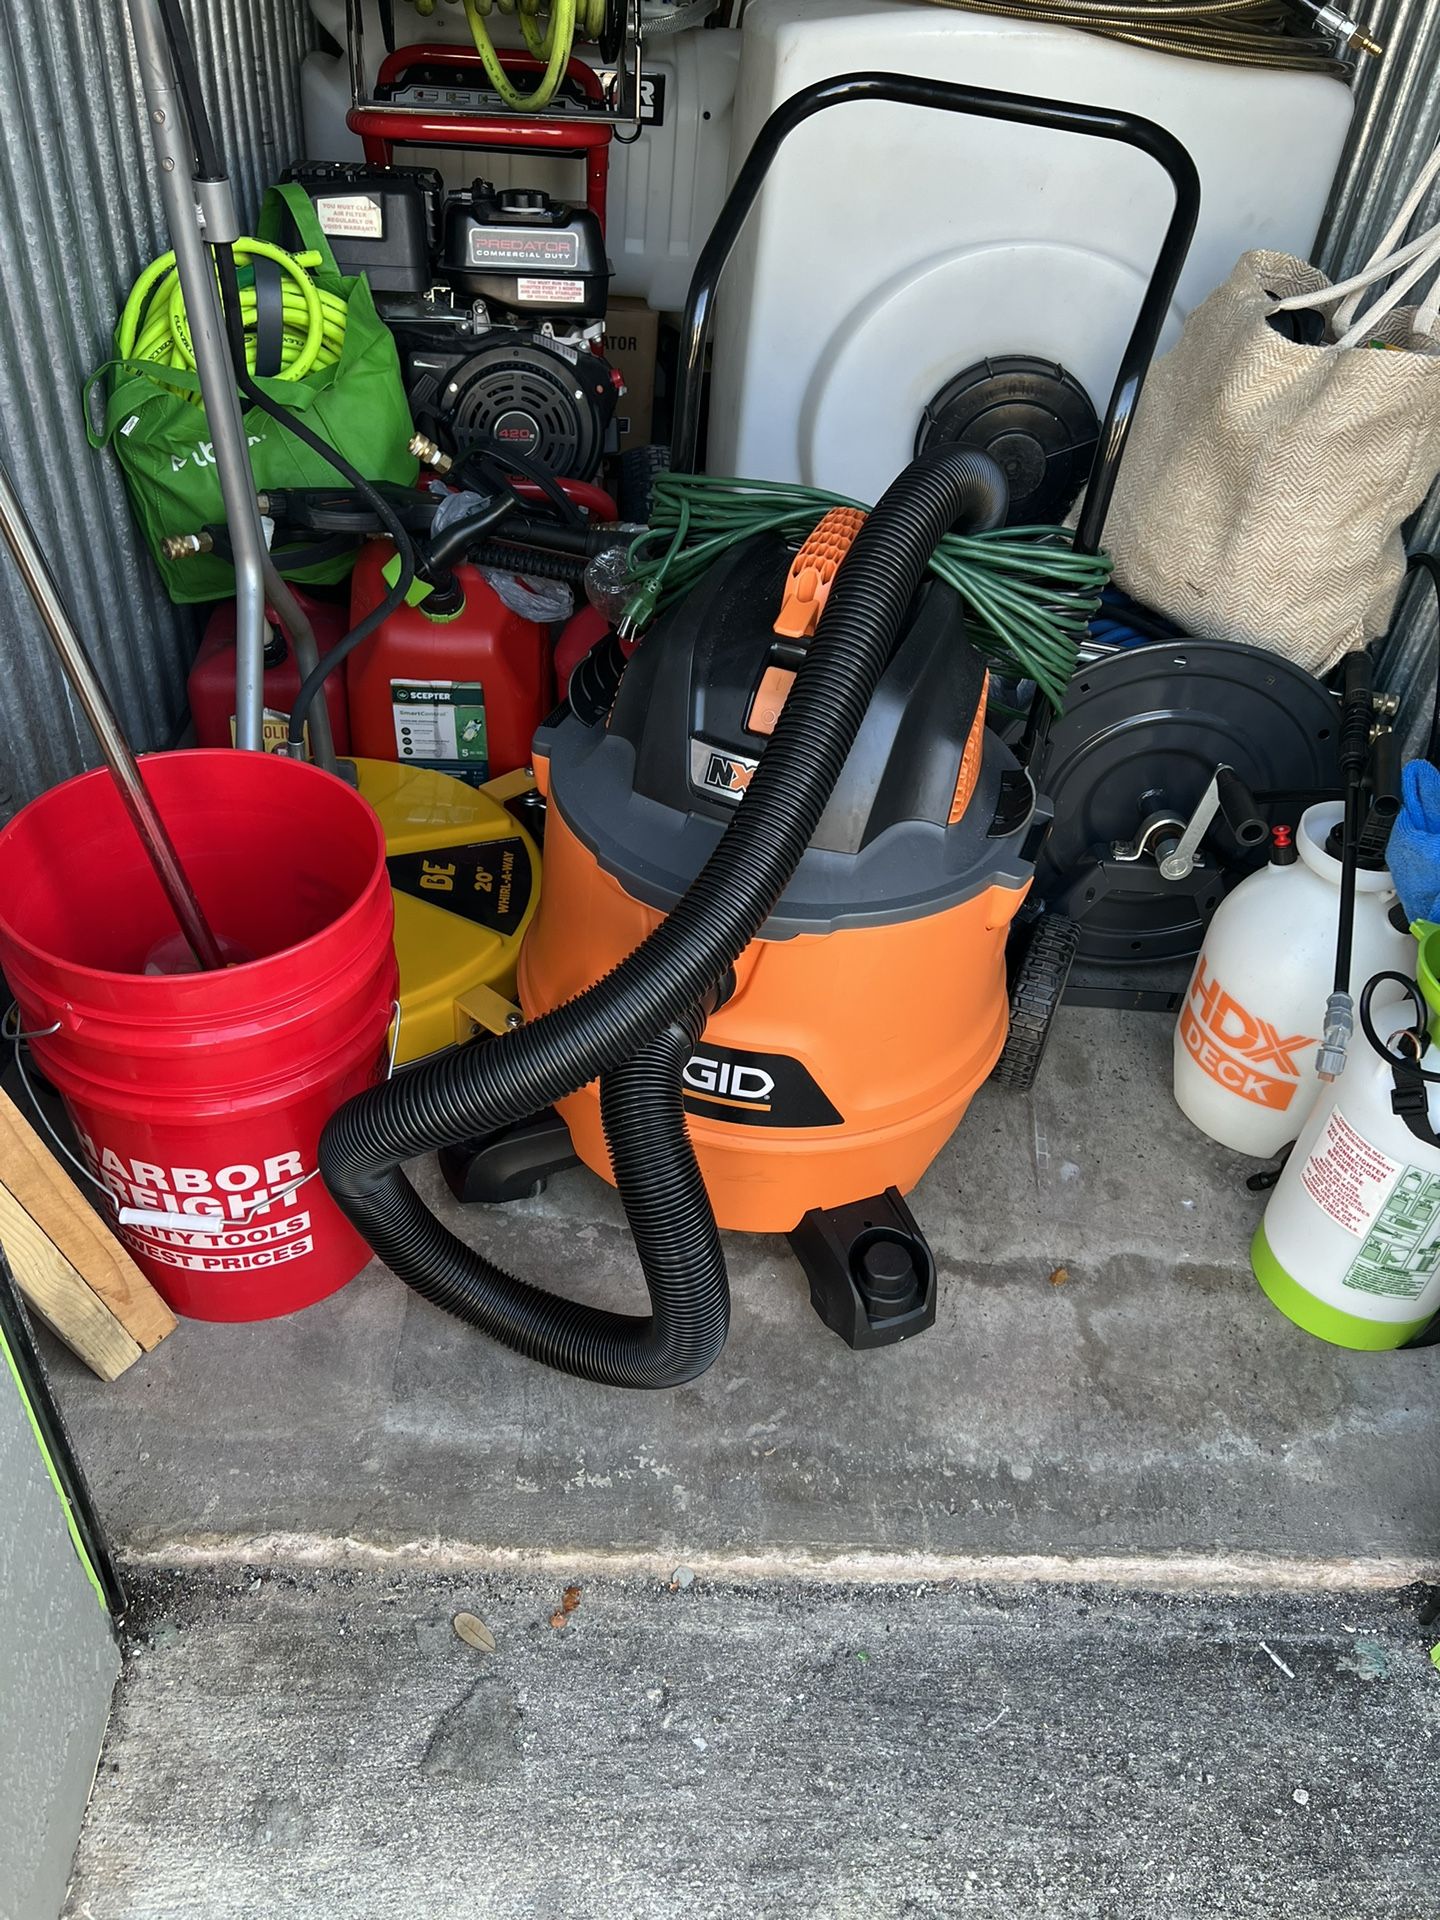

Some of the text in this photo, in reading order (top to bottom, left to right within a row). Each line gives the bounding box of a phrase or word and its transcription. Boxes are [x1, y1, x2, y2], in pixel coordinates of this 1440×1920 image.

[326, 217, 363, 225] REGULARLY
[475, 239, 570, 252] PREDATOR
[476, 250, 541, 259] COMMERCIAL
[410, 692, 451, 701] SCEPTER
[461, 748, 470, 758] 5
[419, 859, 457, 892] BE
[473, 865, 495, 893] 20"
[497, 850, 515, 915] WHIRL-A-WAY
[1190, 954, 1321, 1078] HDX
[1185, 1021, 1274, 1102] DECK
[1329, 1121, 1388, 1179] YOU MUST TIGHTEN
[1338, 1116, 1387, 1161] CONNECTIONS MAY
[1344, 1131, 1364, 1152] DURING
[1363, 1149, 1396, 1173] SHIPMENT
[74, 1124, 304, 1194] HARBOR
[1326, 1148, 1365, 1186] BEFORE USE
[1327, 1129, 1382, 1184] ALL CONNECTIONS
[1332, 1145, 1364, 1178] SECURELY
[84, 1152, 306, 1220] FREIGHT
[1332, 1167, 1347, 1182] ONLY
[1346, 1180, 1360, 1193] FOR
[1340, 1206, 1362, 1223] SPRAY
[204, 1216, 304, 1247] TOOLS
[203, 1240, 308, 1270] PRICES
